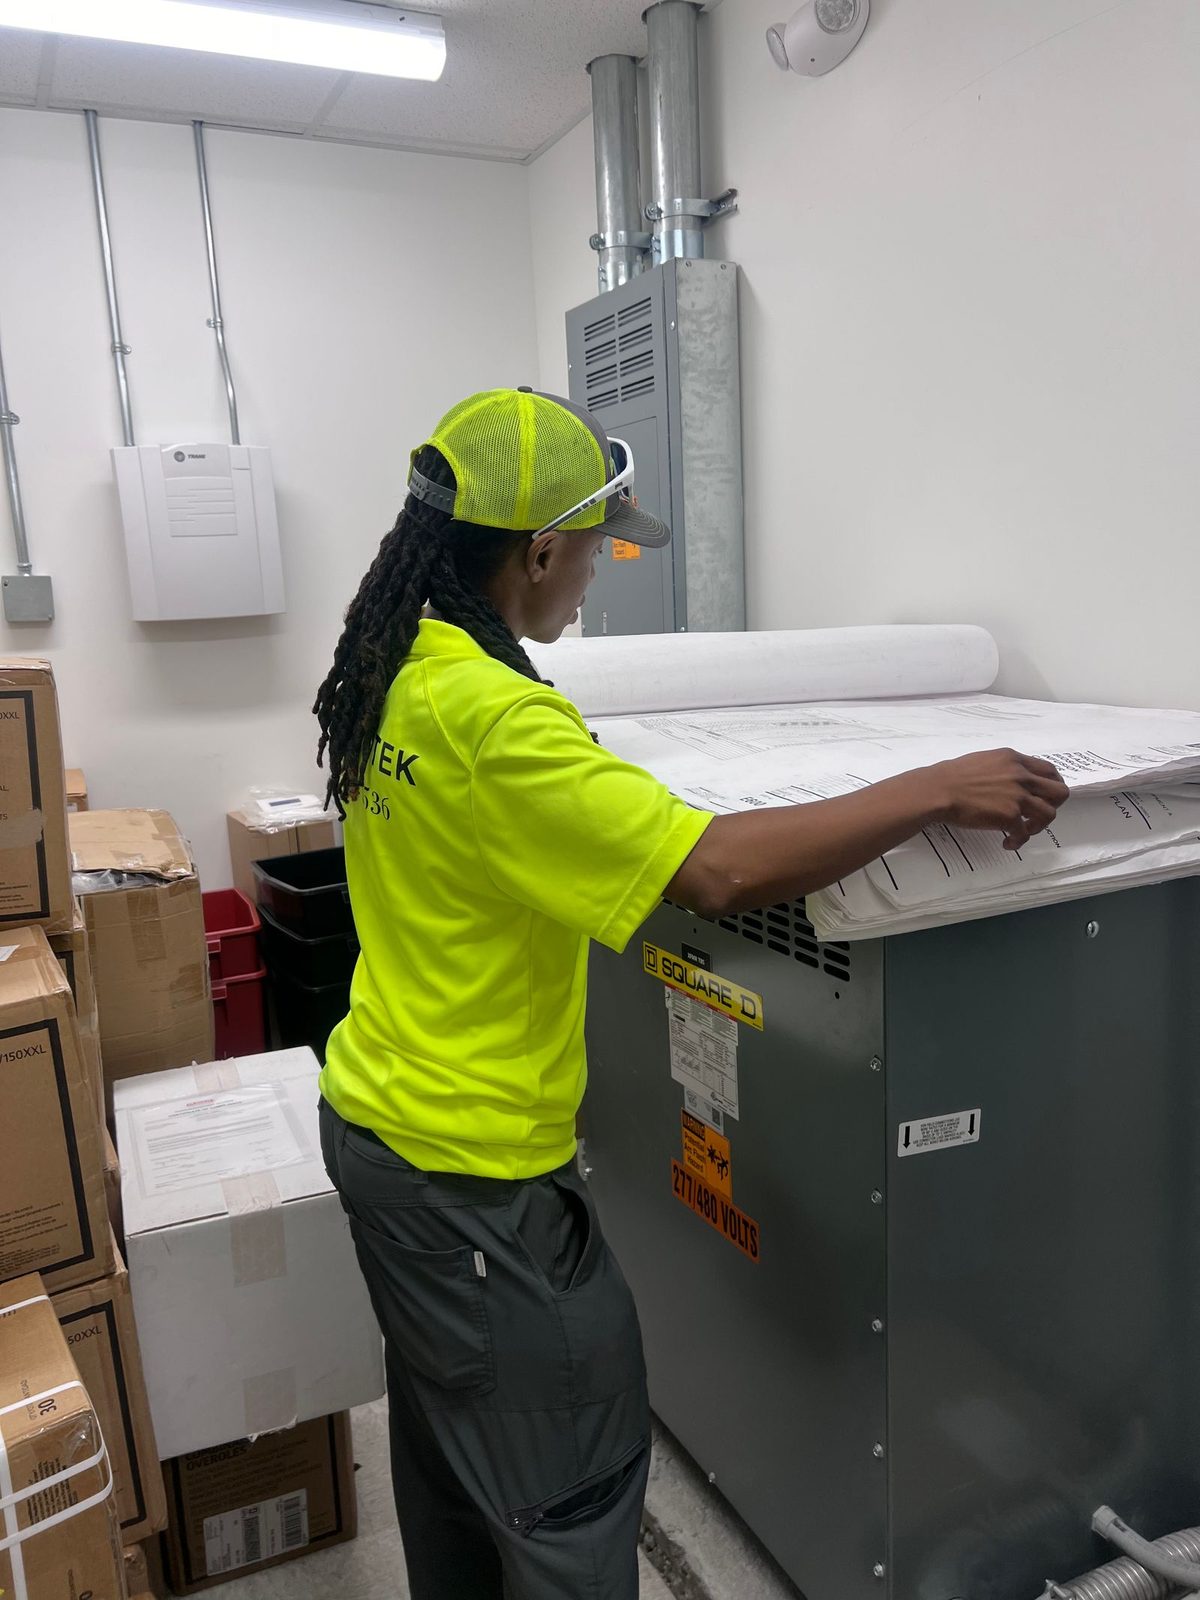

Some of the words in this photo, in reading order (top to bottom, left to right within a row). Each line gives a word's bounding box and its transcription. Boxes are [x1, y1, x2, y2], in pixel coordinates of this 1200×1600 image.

[1110, 794, 1133, 819] PLAN
[661, 956, 733, 1009] SQUARE
[740, 993, 756, 1020] D
[673, 1164, 718, 1225] 277/480
[720, 1200, 758, 1258] VOLTS
